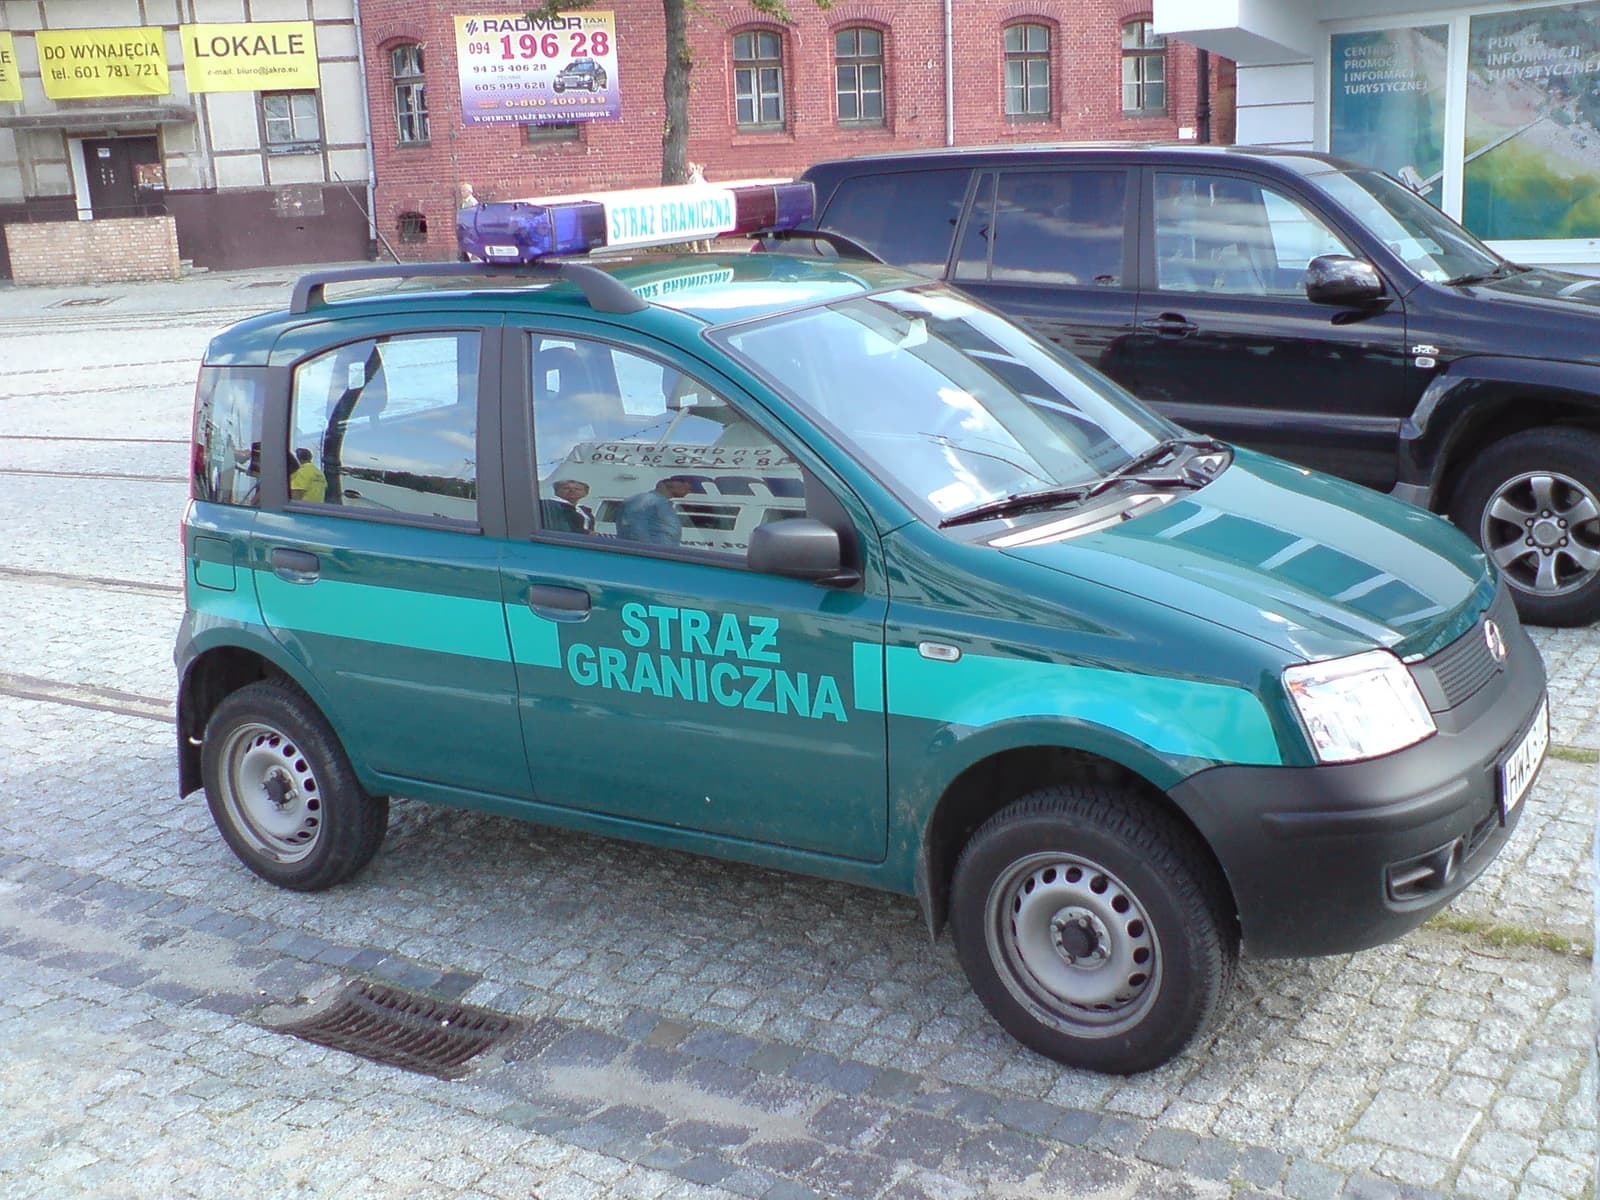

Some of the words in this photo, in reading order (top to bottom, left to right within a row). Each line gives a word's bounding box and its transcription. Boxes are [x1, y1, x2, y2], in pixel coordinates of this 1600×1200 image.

[483, 17, 582, 32] RADMOR
[43, 46, 66, 61] DO
[69, 42, 161, 60] WYNAJĘCIA
[194, 34, 305, 58] LOKALE
[468, 42, 491, 55] 094
[500, 33, 560, 60] 196
[569, 31, 610, 58] 28
[51, 68, 71, 81] tel.
[74, 66, 101, 79] 601
[105, 65, 131, 79] 781
[135, 64, 160, 77] 721
[474, 83, 497, 91] 605
[1344, 80, 1427, 95] TURYSTYCZNEJ
[661, 198, 732, 234] GRANICZNA
[566, 642, 849, 723] GRANICZNA
